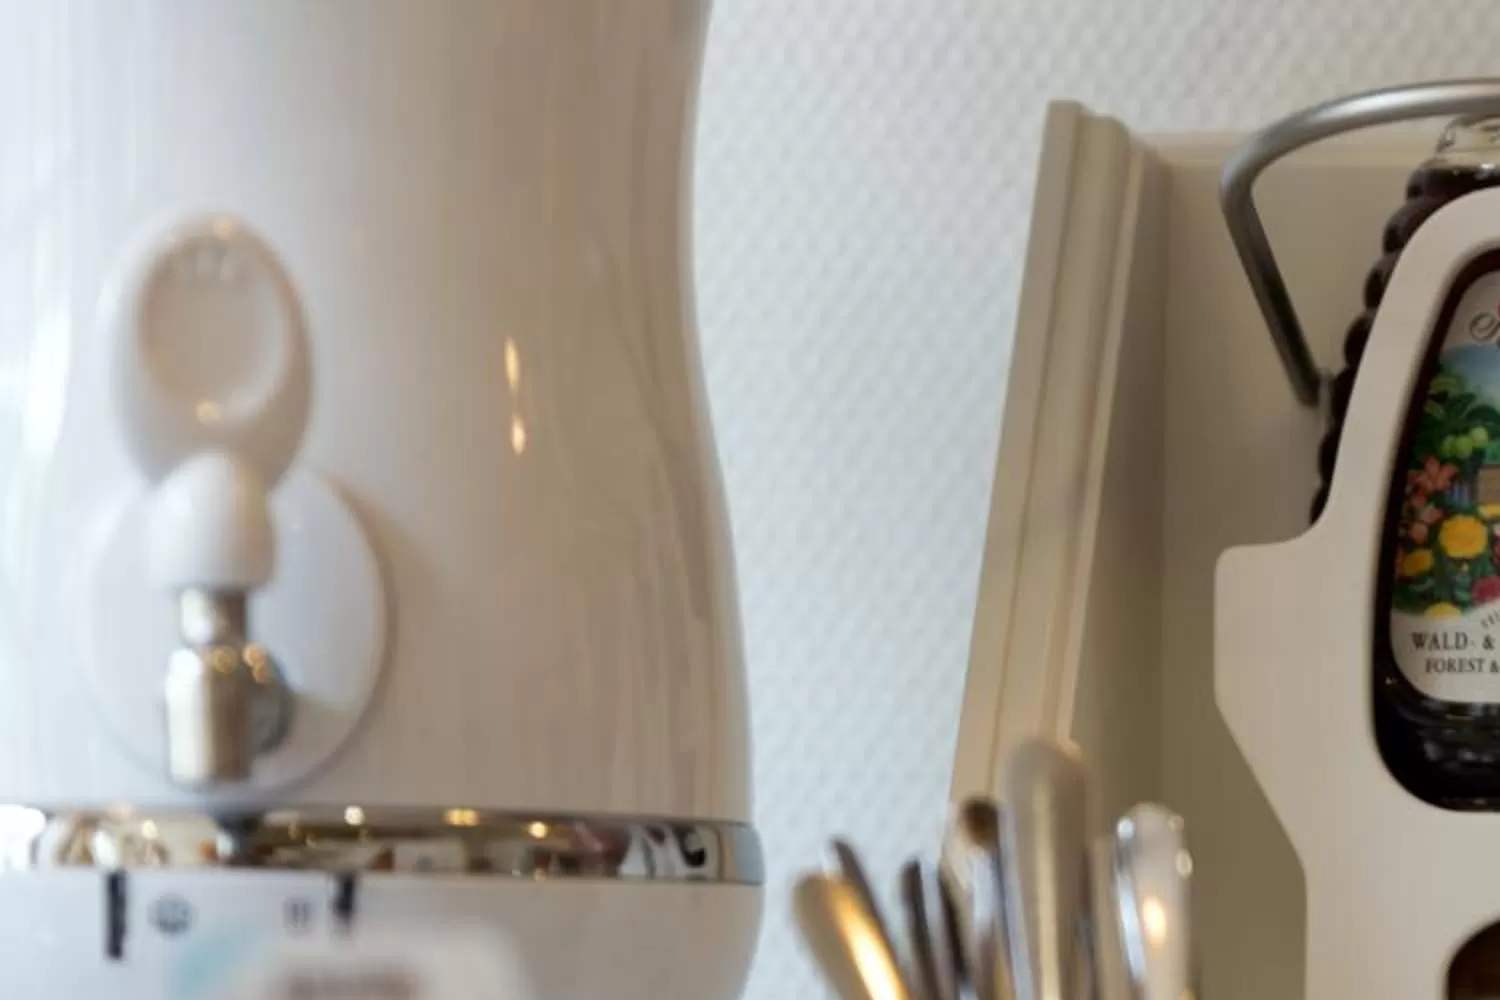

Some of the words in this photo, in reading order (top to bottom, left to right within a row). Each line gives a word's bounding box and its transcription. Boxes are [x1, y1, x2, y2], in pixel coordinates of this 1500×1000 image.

[1481, 633, 1496, 651] &
[1424, 656, 1486, 675] FOREST
[1489, 659, 1500, 674] &
